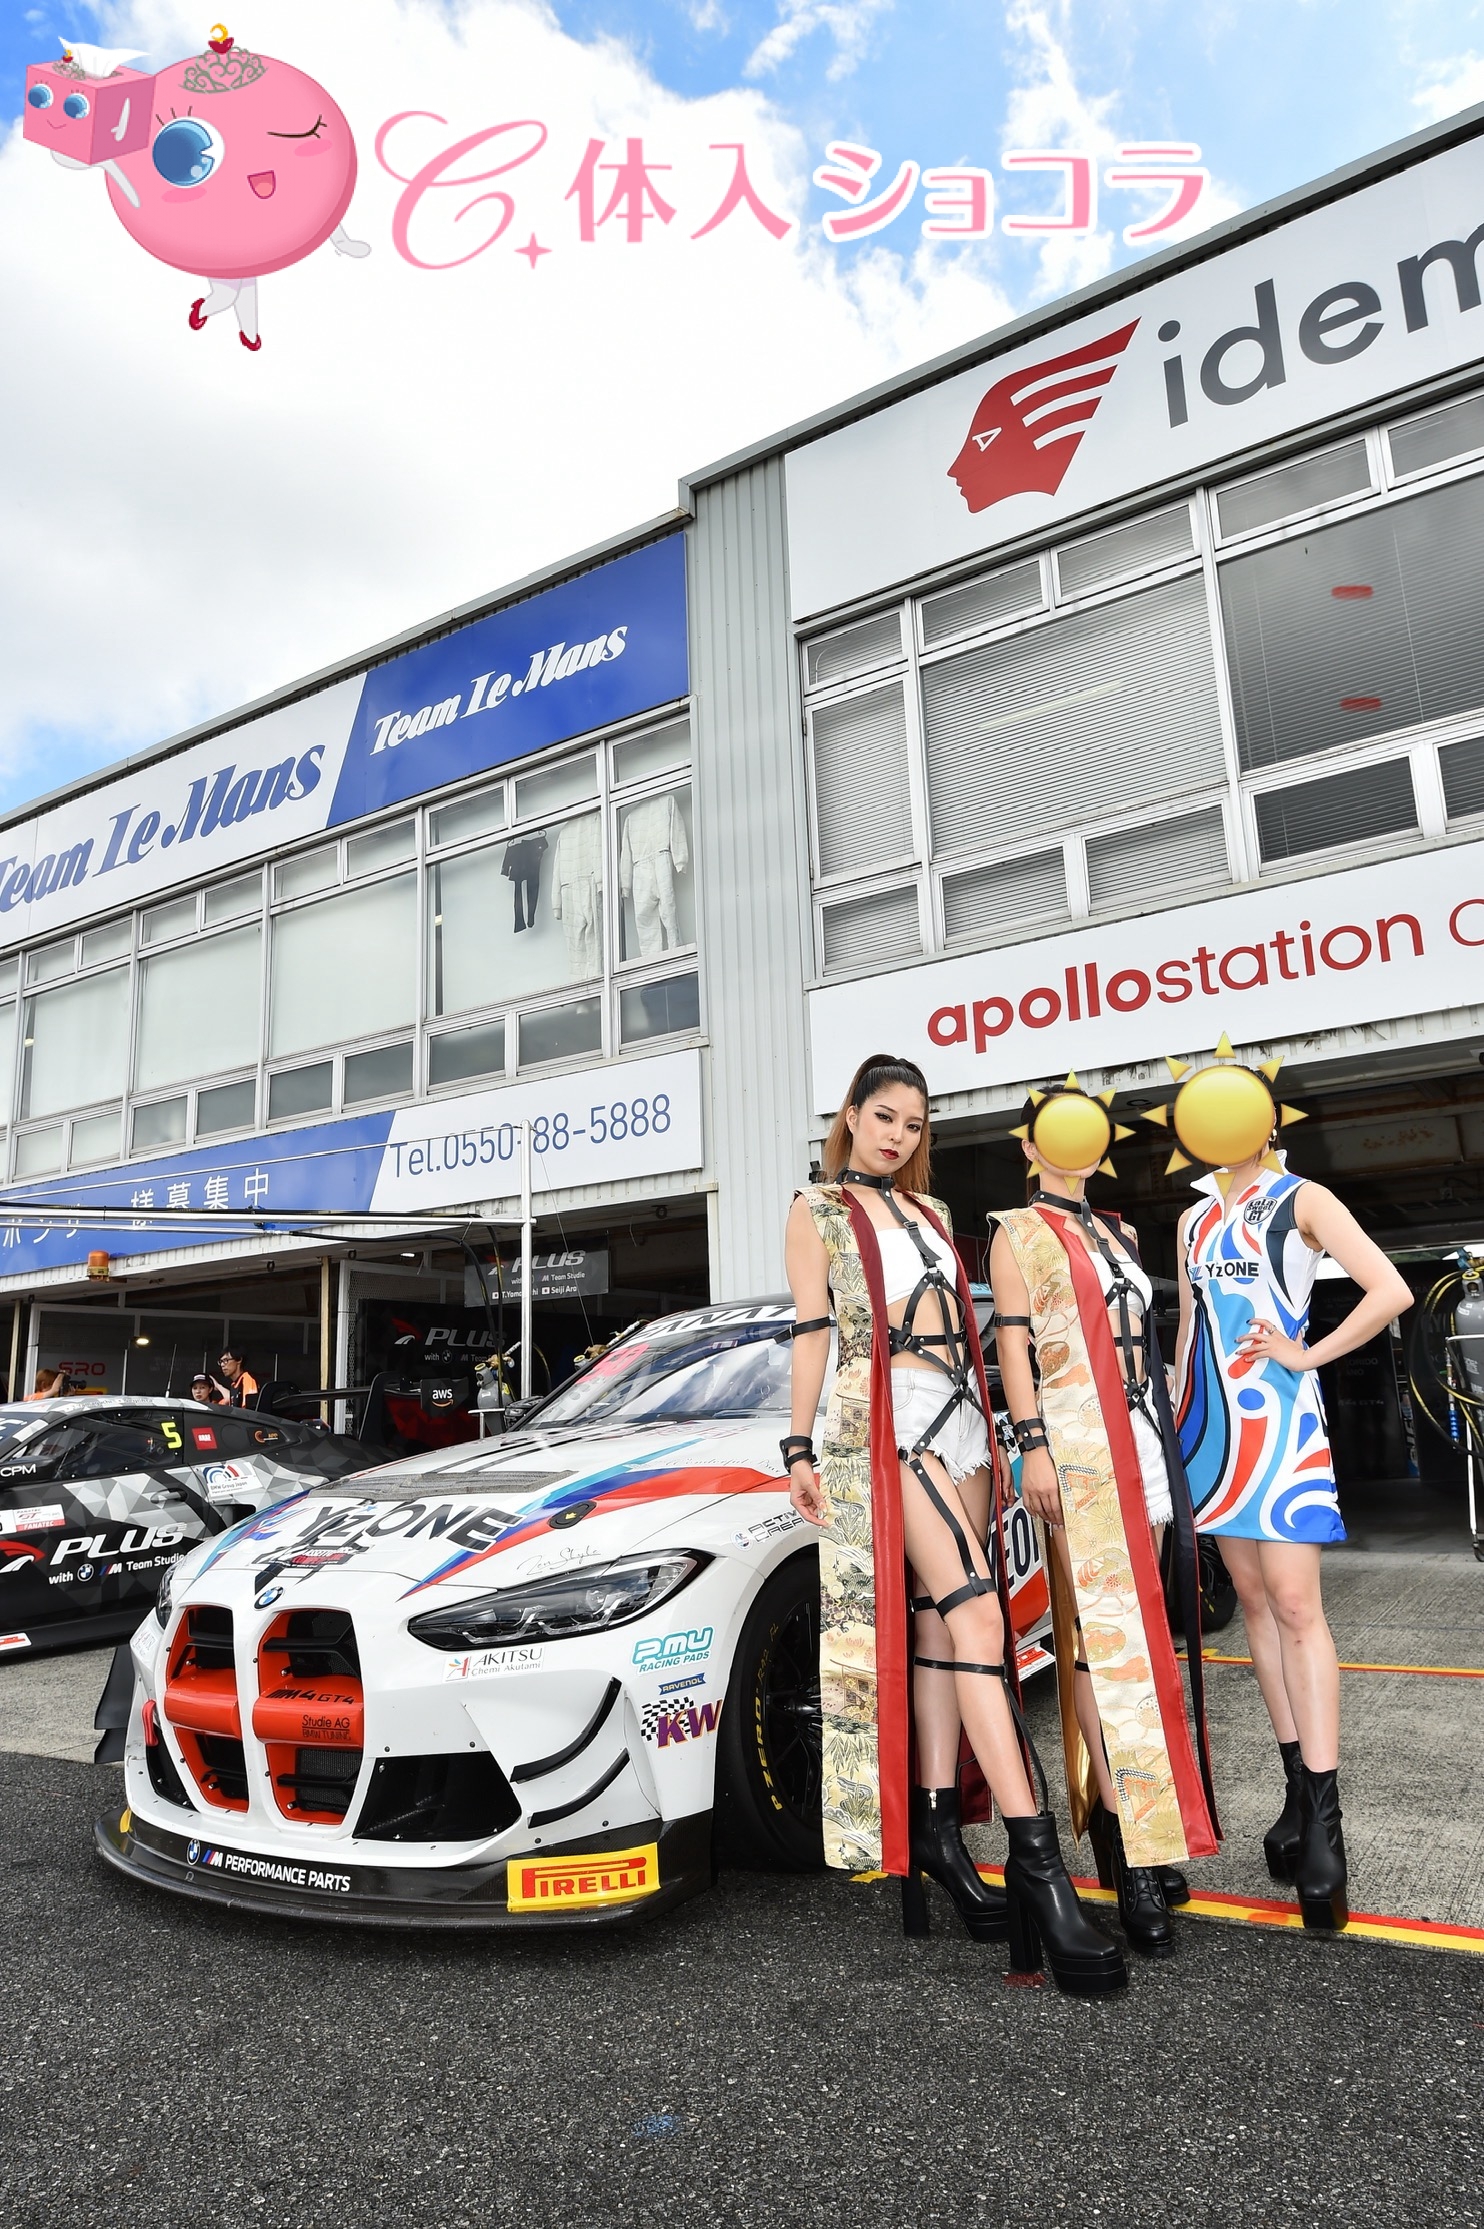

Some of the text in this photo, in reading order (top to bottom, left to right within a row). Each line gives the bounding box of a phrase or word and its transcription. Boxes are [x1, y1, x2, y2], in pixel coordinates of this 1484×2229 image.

[370, 690, 462, 755] Team
[511, 626, 628, 697] Mans
[161, 744, 325, 848] Mans
[927, 913, 1425, 1054] apollostation
[1249, 1210, 1265, 1221] GT
[425, 1326, 507, 1348] PLUS
[424, 1353, 440, 1361] with
[59, 1362, 106, 1376] SRO
[432, 1388, 453, 1400] aws
[161, 1421, 183, 1449] 5
[0, 1463, 37, 1478] CPM
[24, 1521, 55, 1531] FANATEC
[50, 1522, 187, 1566] PLUS
[49, 1571, 73, 1584] with
[127, 1559, 153, 1572] Team
[473, 1647, 543, 1667] AKITSU
[639, 1650, 710, 1673] RACING PADS
[661, 1676, 703, 1693] RAVENOL
[317, 1693, 355, 1705] GT4
[302, 1714, 350, 1729] Studie AG
[657, 1699, 723, 1748] KW
[302, 1728, 321, 1739] BMW
[225, 1854, 306, 1885] PERFORMANCE
[308, 1870, 351, 1892] PARTS
[521, 1856, 647, 1899] PIRELLI
